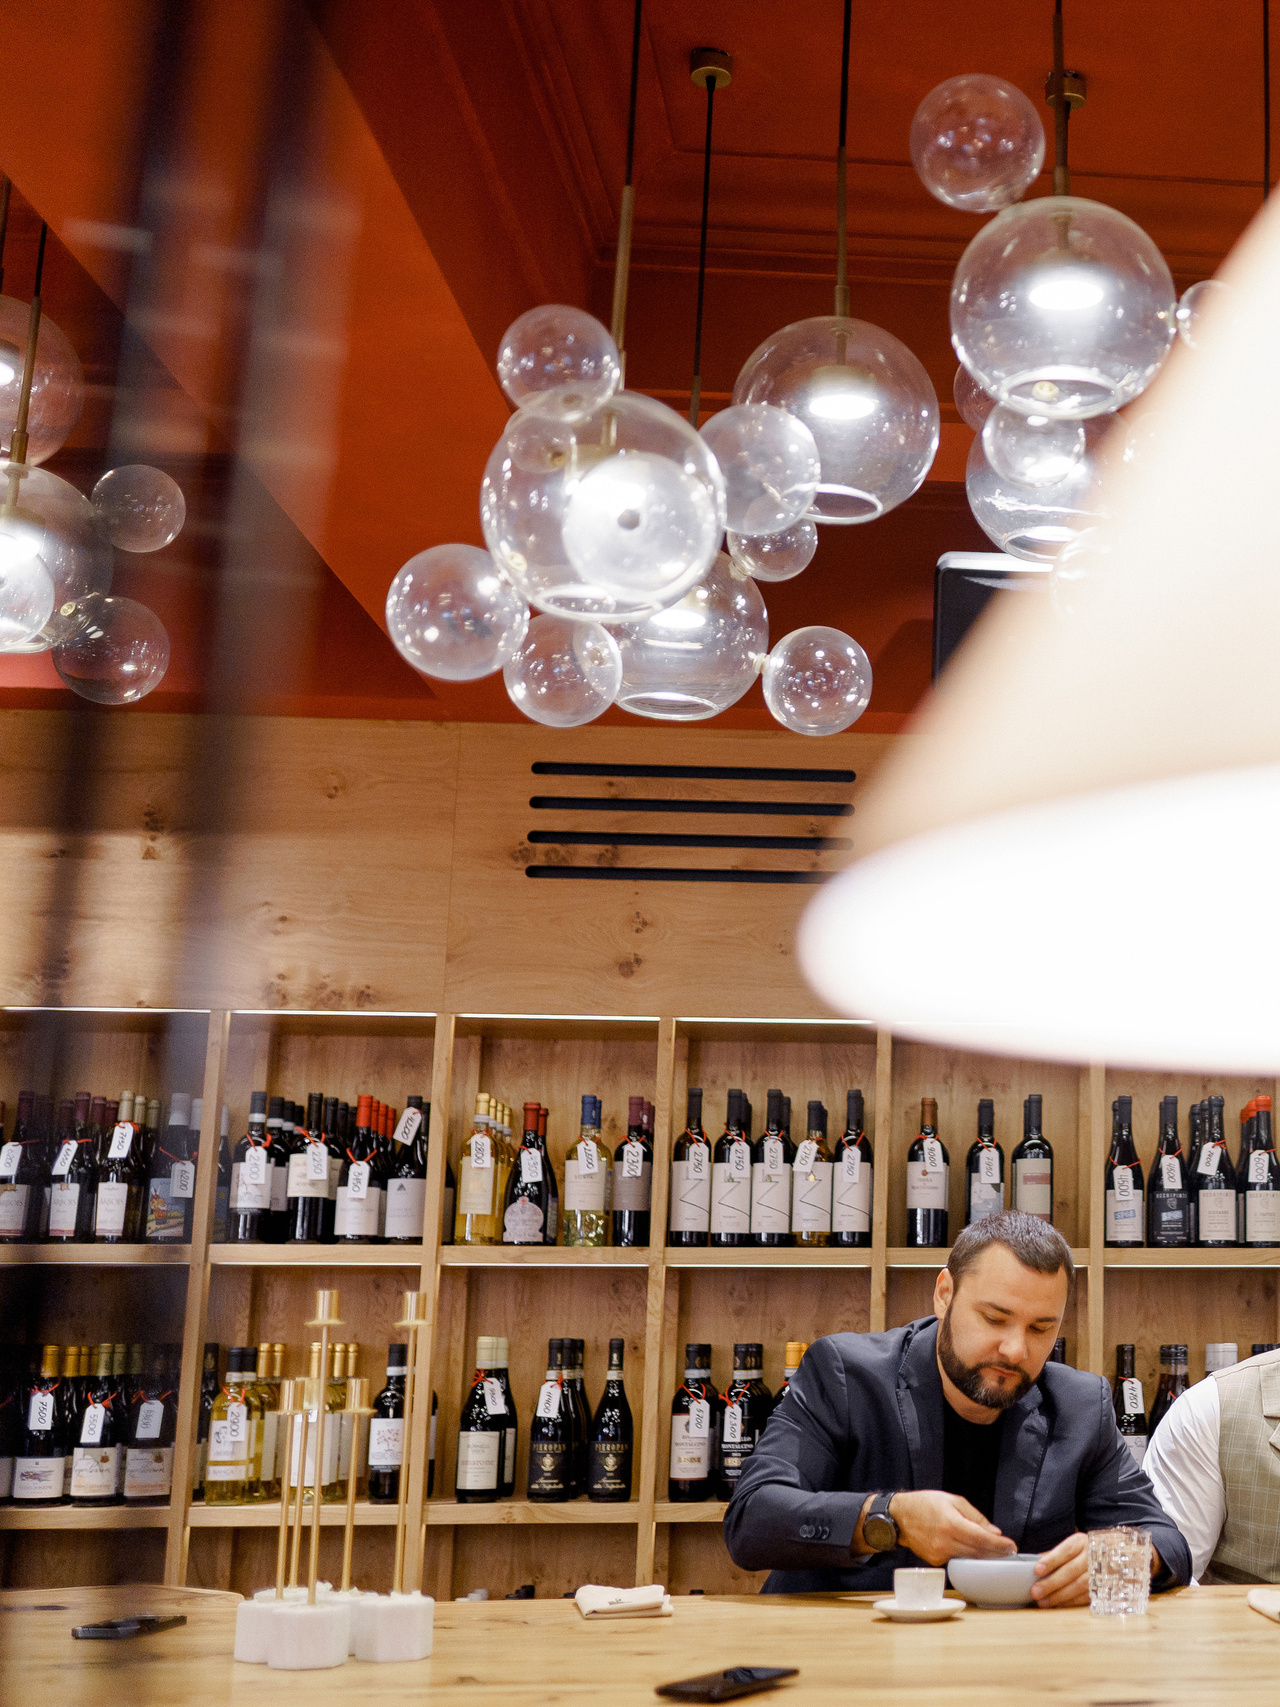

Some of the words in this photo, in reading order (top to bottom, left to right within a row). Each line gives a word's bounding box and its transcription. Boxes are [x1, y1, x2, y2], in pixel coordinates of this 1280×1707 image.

[692, 1151, 703, 1174] 2750
[735, 1148, 745, 1171] 2750
[769, 1147, 778, 1170] 2750
[799, 1145, 812, 1166] 2750
[847, 1154, 856, 1176] 2750
[929, 1146, 937, 1168] 9000
[1168, 1161, 1177, 1183] 4500
[1254, 1157, 1265, 1181] 6000
[1119, 1173, 1131, 1197] 4500
[38, 1401, 47, 1424] 7500
[230, 1411, 240, 1437] 2900
